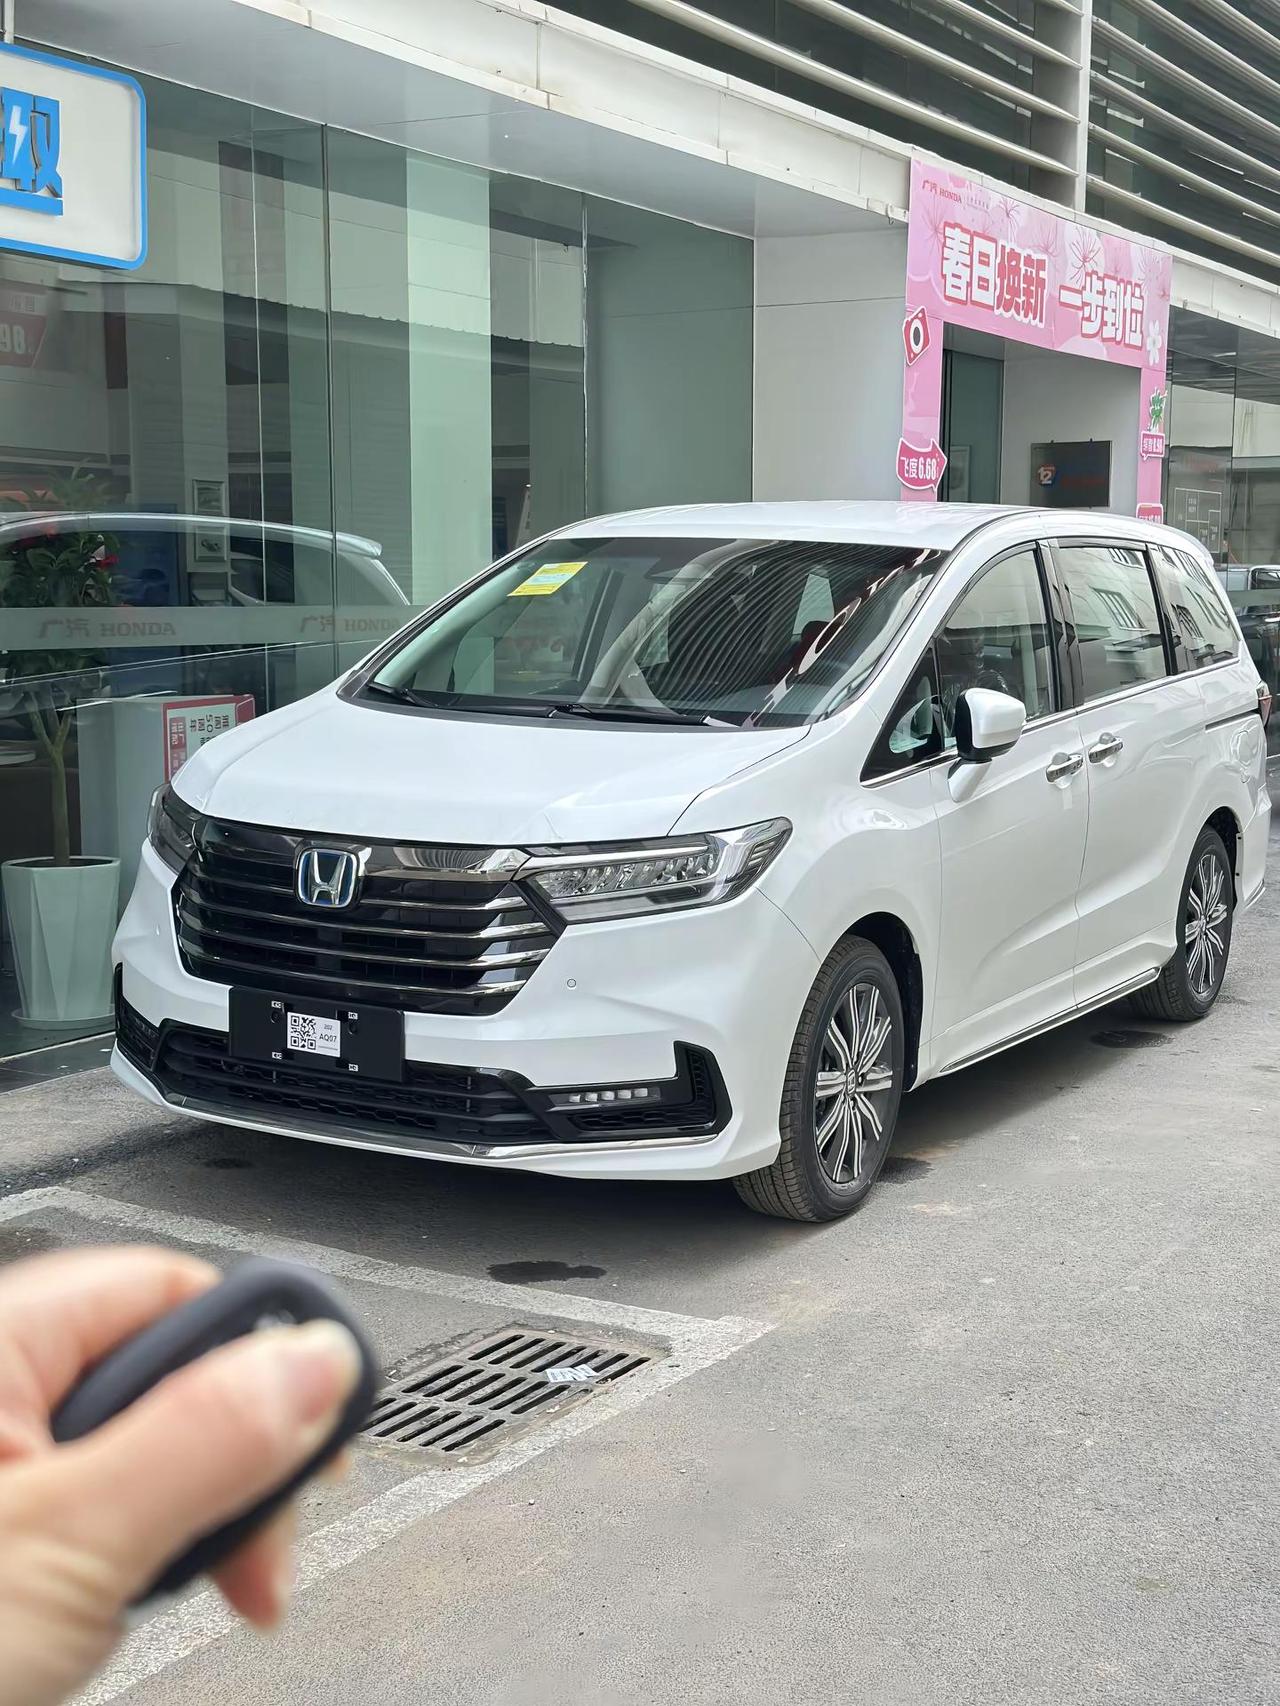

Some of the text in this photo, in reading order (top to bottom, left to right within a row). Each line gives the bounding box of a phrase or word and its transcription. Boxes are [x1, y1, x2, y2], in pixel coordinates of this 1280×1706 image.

[939, 188, 962, 203] HONDA
[1058, 270, 1145, 350] 一步到位
[900, 456, 937, 480] 飞度6.68
[37, 617, 176, 638] 广汽 HONDA
